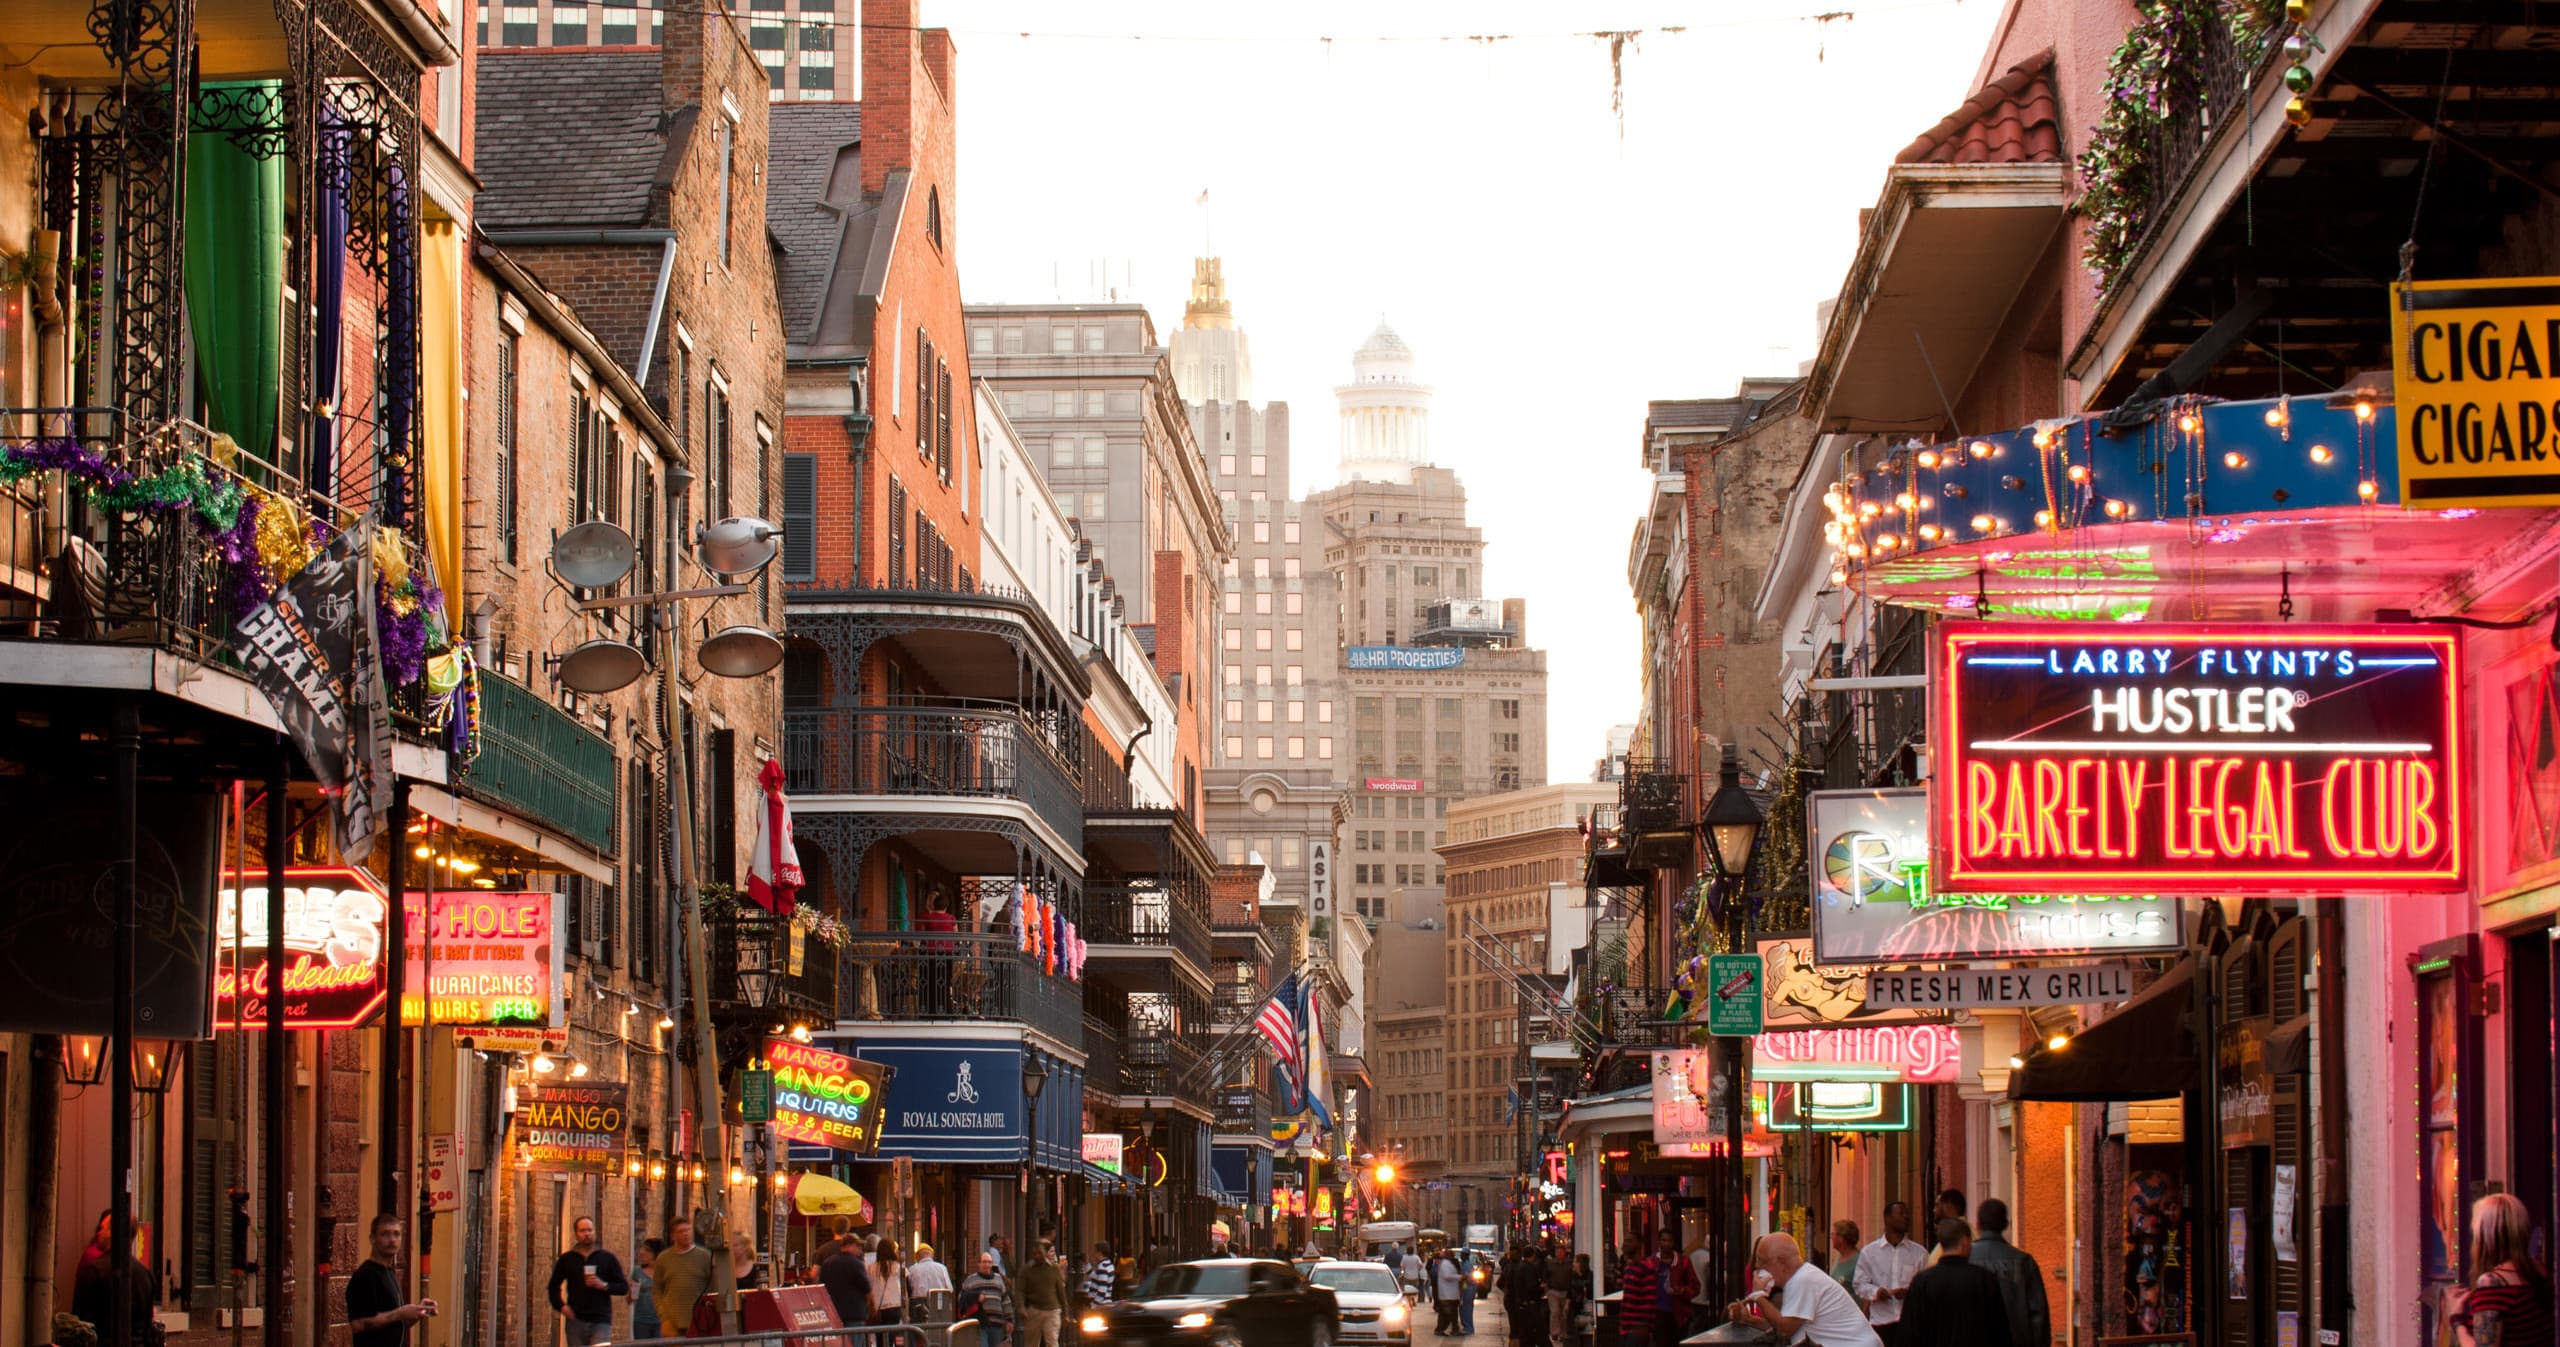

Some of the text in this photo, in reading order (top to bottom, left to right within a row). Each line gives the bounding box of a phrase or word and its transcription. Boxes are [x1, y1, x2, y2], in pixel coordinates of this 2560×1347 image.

[277, 600, 330, 682] SUPER
[1368, 651, 1388, 667] HRI
[1391, 650, 1457, 667] PROPERTIES
[2049, 649, 2354, 676] LARRY FLYNT'S
[1371, 779, 1418, 791] woodward
[1967, 757, 2440, 859] BARELY LEGAL CLUB
[450, 903, 540, 939] HOLE
[2018, 910, 2163, 938] HOUSE
[252, 955, 372, 997] Oleans
[1873, 970, 2129, 1002] FRESH MEX GRILL
[242, 998, 308, 1019] Caret
[402, 1000, 537, 1019] AIUIRIS BEER
[772, 1044, 847, 1072] MANGO
[545, 1088, 601, 1103] MANGO
[527, 1102, 620, 1131] MANGO
[804, 1115, 816, 1128] &
[822, 1120, 864, 1140] BEER
[903, 1111, 1005, 1128] ROYAL SONESTA HOTEL
[529, 1130, 612, 1149] DAIQUIRIS
[532, 1147, 575, 1160] COCKTAILS
[586, 1151, 607, 1162] BEER
